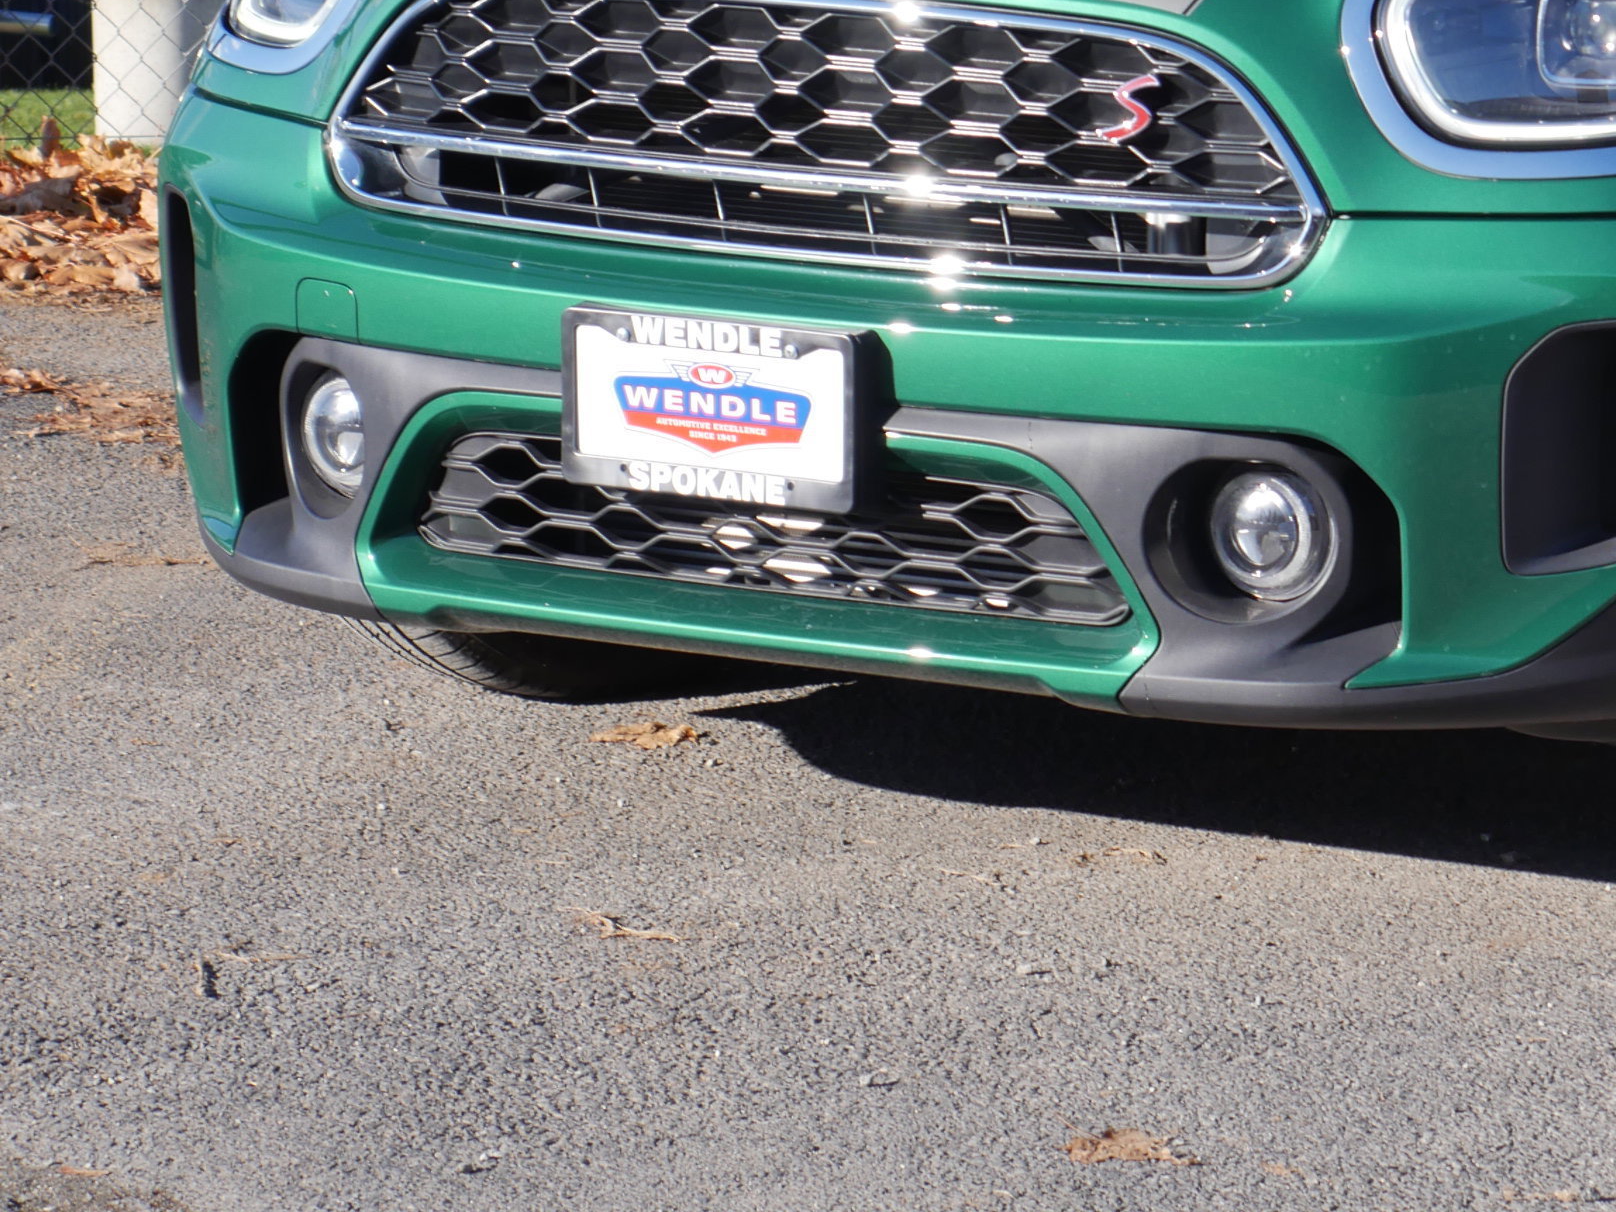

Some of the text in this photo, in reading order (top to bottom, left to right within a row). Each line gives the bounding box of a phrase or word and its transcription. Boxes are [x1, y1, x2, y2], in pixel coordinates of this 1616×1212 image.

[1096, 74, 1160, 145] S
[630, 315, 783, 358] WENDLE
[622, 384, 798, 426] WENDLE
[656, 416, 768, 437] AUTOMOTIVE EXCELLENCE
[689, 430, 715, 441] SINCE
[628, 460, 786, 506] SPOKANE
